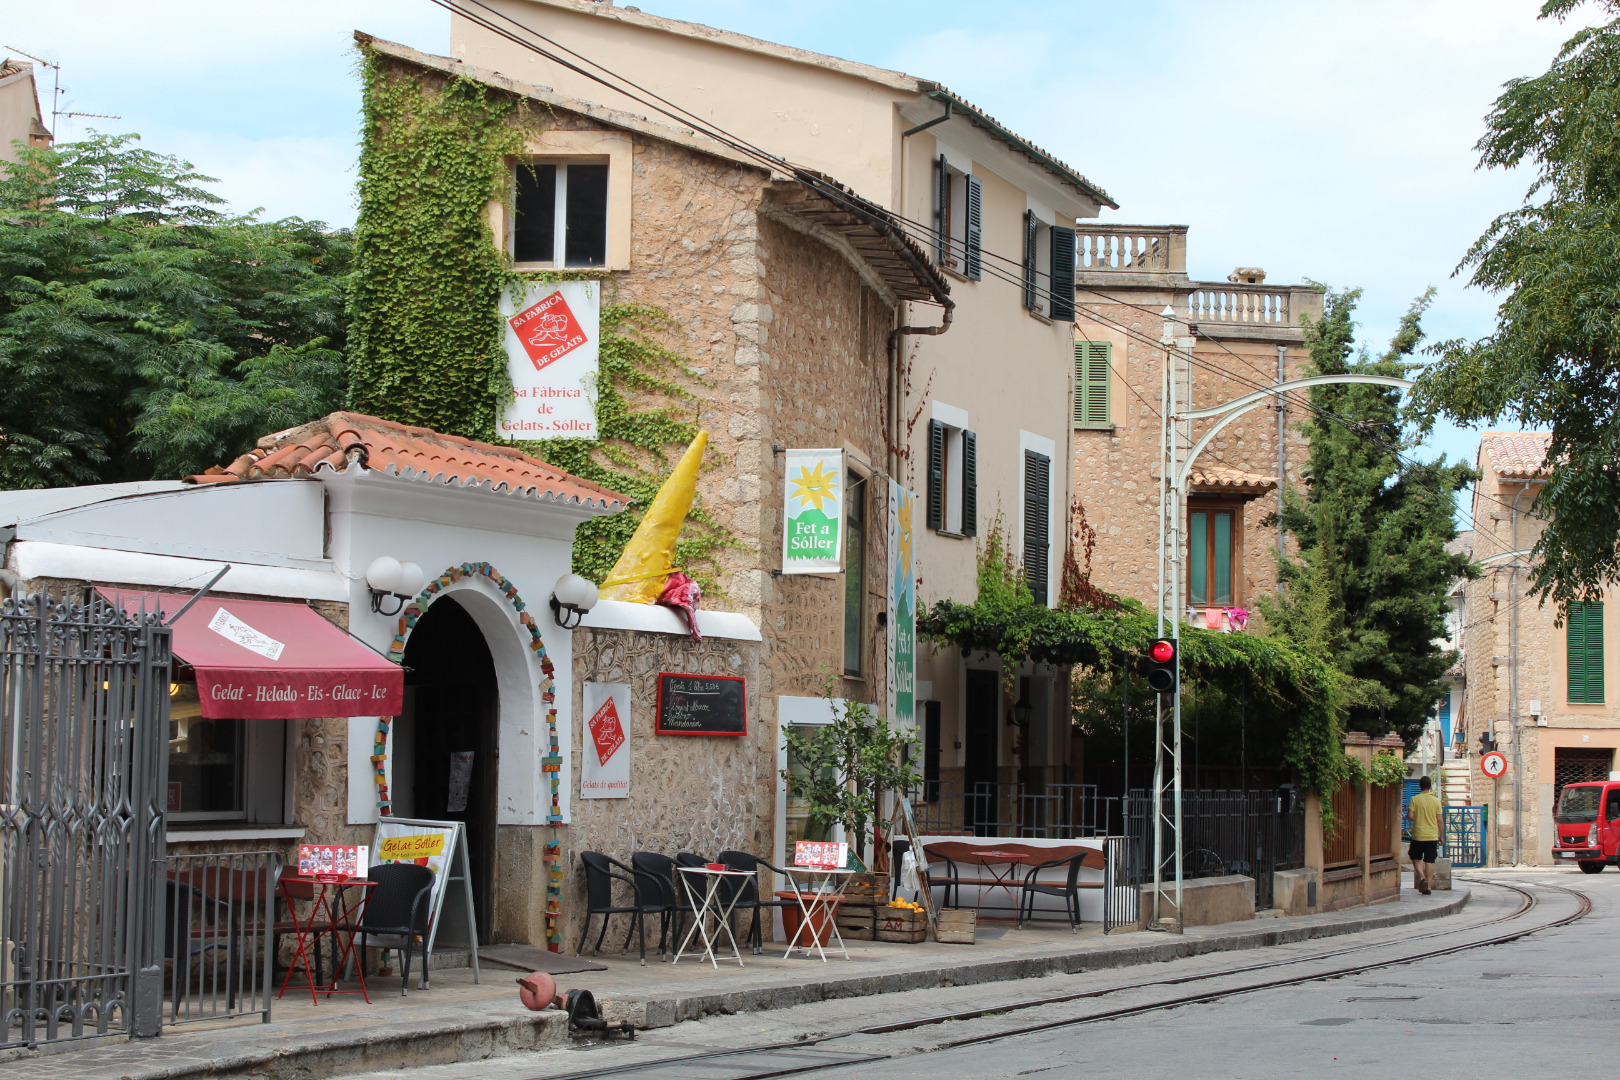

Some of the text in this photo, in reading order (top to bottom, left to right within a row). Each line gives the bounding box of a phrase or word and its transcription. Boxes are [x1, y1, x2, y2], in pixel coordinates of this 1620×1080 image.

[513, 295, 562, 328] SA FABRICA
[536, 334, 583, 367] DE GELATS
[513, 386, 581, 398] Sa Fàbrica
[537, 403, 553, 414] de
[501, 419, 544, 431] Gelats
[552, 419, 592, 431] Sóller
[795, 522, 830, 534] Fet a
[791, 535, 834, 550] Sóller
[211, 683, 244, 700] Gelat
[255, 685, 297, 702] Helado
[307, 685, 323, 701] Eis
[332, 684, 361, 700] Glace
[371, 684, 387, 699] Ice
[582, 780, 600, 789] Gelats
[384, 839, 412, 852] Gelat
[884, 921, 902, 930] AM
